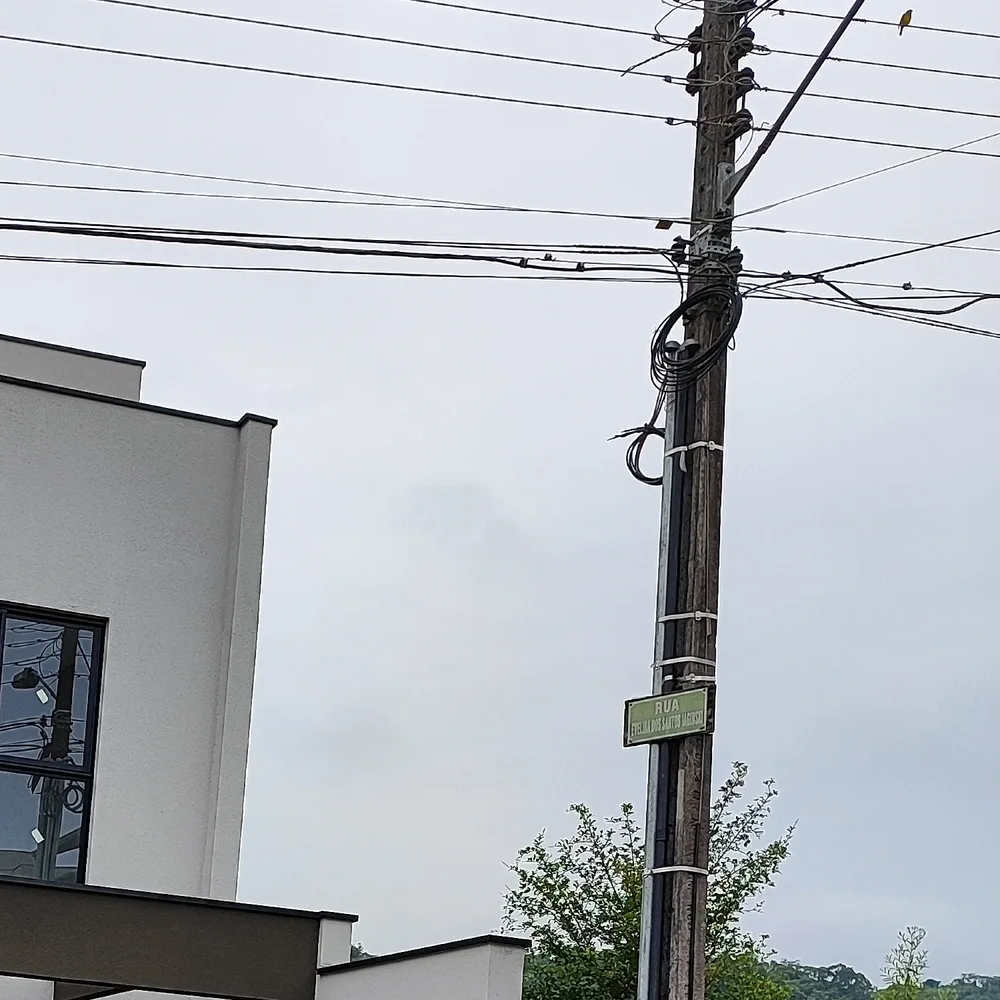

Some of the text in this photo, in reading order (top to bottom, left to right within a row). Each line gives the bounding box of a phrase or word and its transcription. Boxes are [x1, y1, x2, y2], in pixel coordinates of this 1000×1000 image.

[655, 698, 679, 715] RUA
[651, 717, 661, 733] DOS
[661, 713, 681, 731] SANTOS
